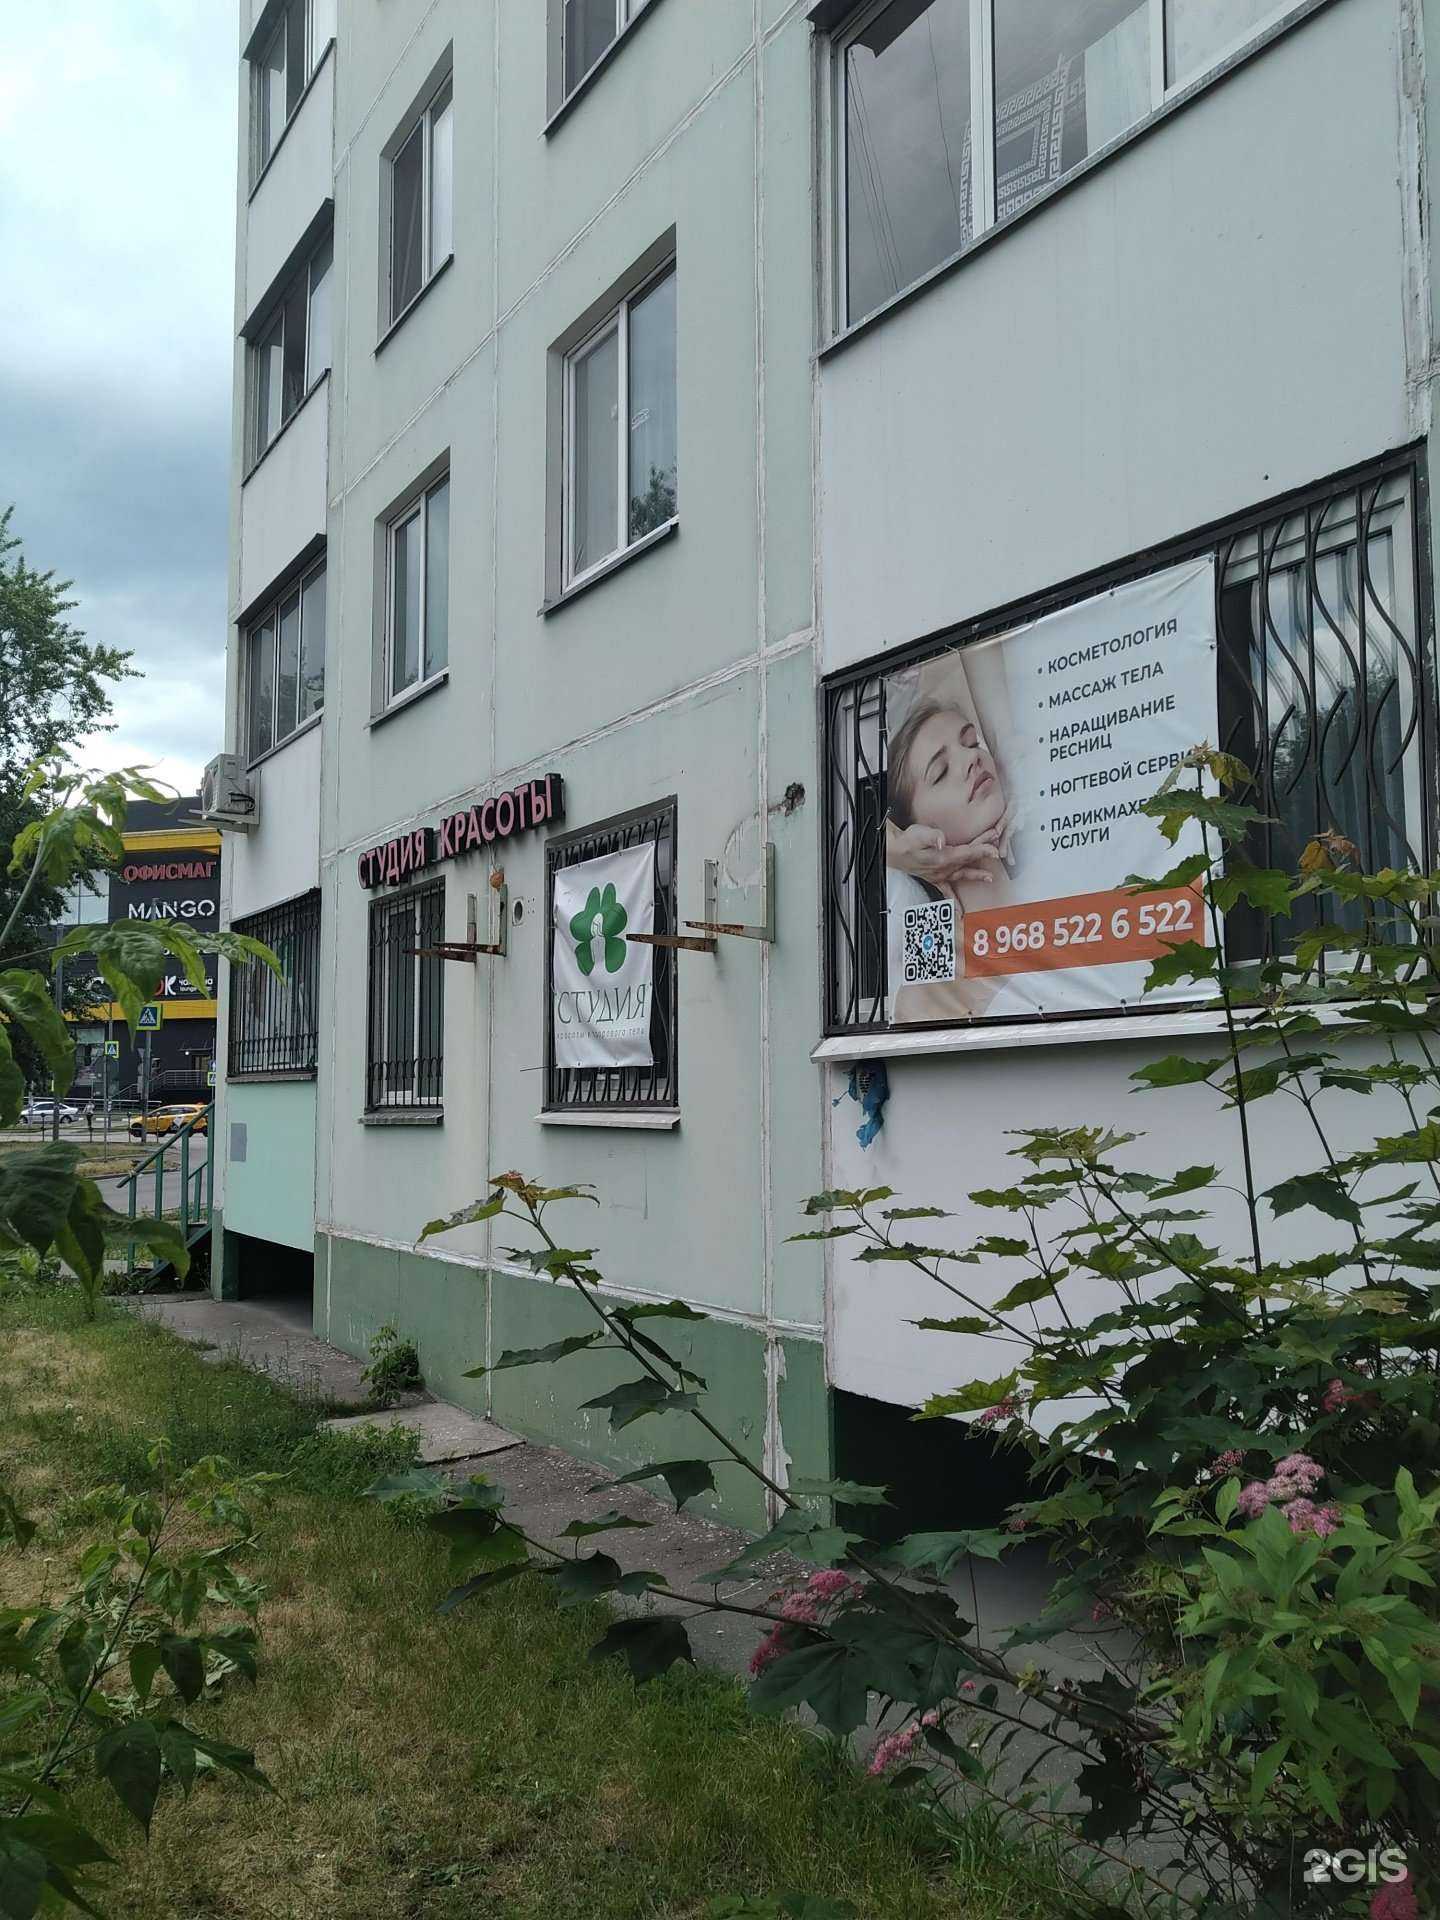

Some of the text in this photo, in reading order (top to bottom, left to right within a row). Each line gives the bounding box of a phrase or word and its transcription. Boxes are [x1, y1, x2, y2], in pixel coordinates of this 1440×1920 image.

[1048, 618, 1177, 674] КОСМЕТОЛОГИЯ
[1049, 661, 1164, 709] МАССАЖ ТЕЛА
[1049, 694, 1176, 743] НАРАЩИВАНИЕ
[1050, 733, 1112, 762] РЕСНИЦ
[1050, 749, 1195, 797] НОГТЕВОЙ СЕРВ
[357, 773, 556, 890] СТУДИЯ КРАСОТЫ
[1051, 827, 1110, 851] УСЛУГИ
[123, 861, 217, 881] ОФИСМАГ
[128, 899, 215, 920] MANGO
[973, 899, 1194, 956] 8 968 522 6 522
[557, 984, 647, 1025] СТУДИЯ
